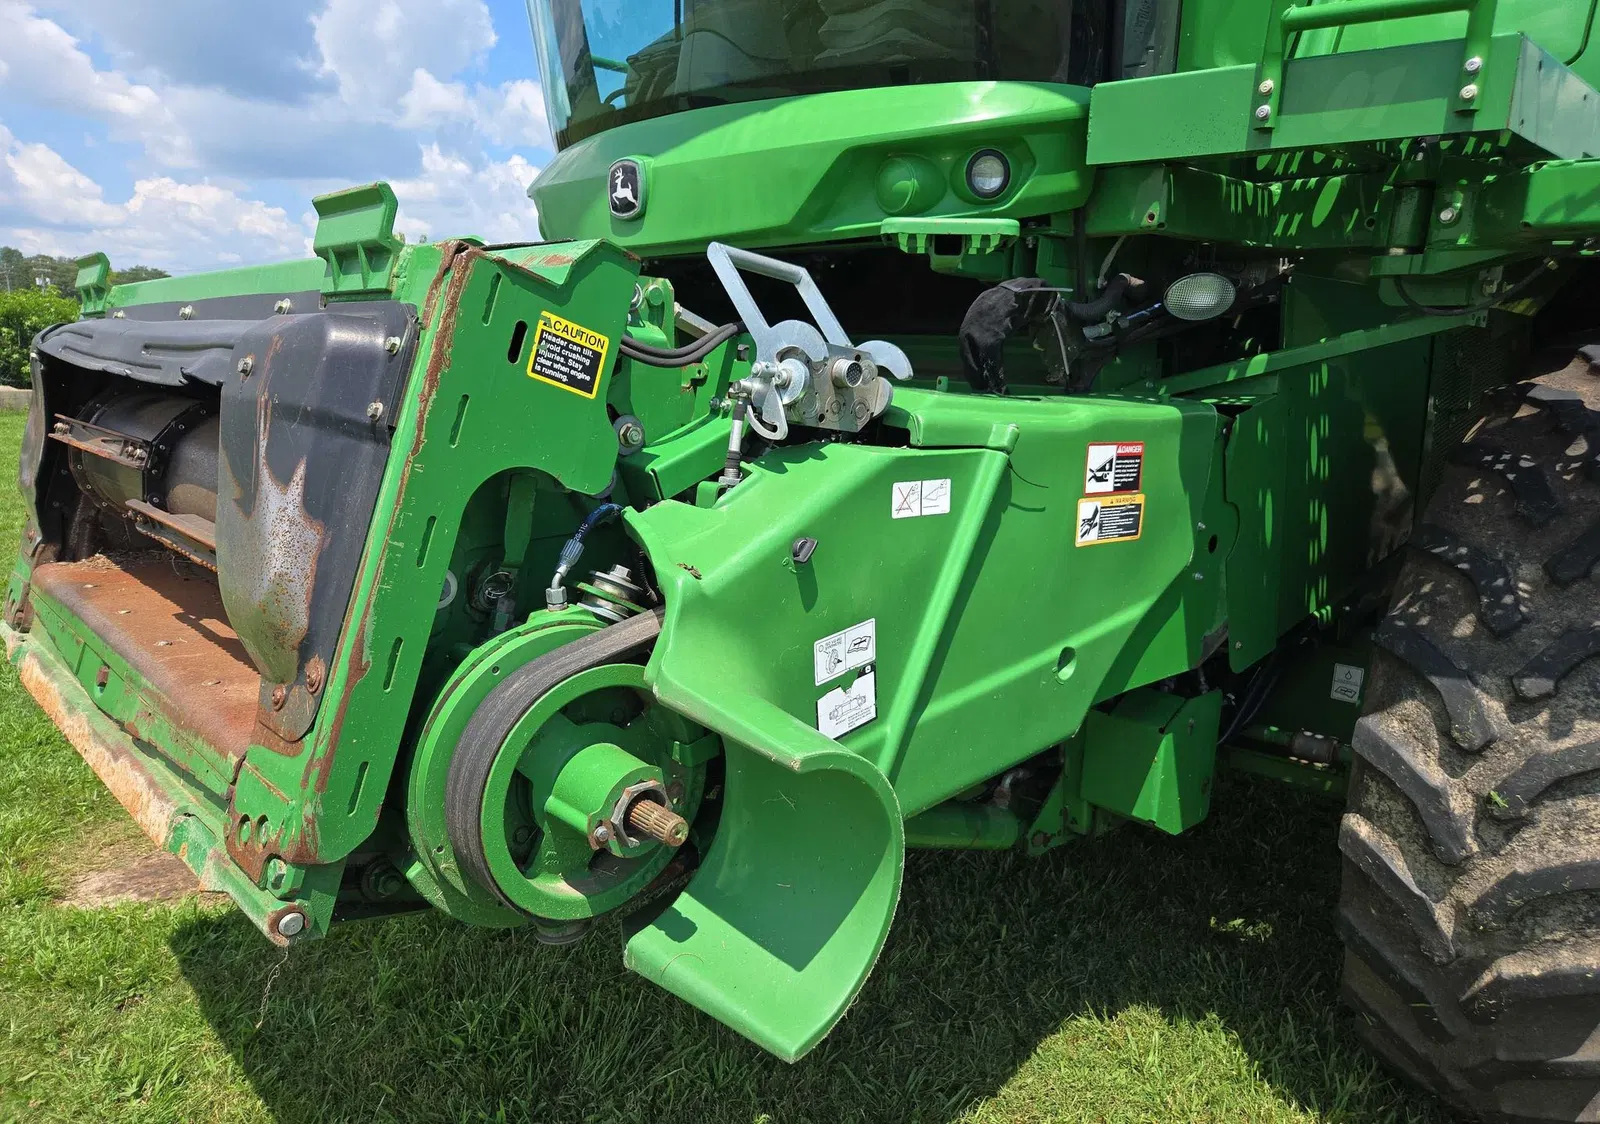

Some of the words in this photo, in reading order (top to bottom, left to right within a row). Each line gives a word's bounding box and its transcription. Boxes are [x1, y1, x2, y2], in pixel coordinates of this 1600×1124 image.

[542, 332, 568, 346] Header
[568, 343, 582, 352] can
[582, 348, 594, 358] tilt.
[554, 320, 605, 350] CAUTION
[540, 340, 560, 353] Avoid
[562, 350, 590, 366] crushing
[568, 358, 583, 370] Stay
[536, 356, 552, 366] clear
[553, 362, 570, 374] when
[570, 370, 591, 382] engine
[542, 366, 568, 382] running.
[1120, 445, 1142, 453] DANGER
